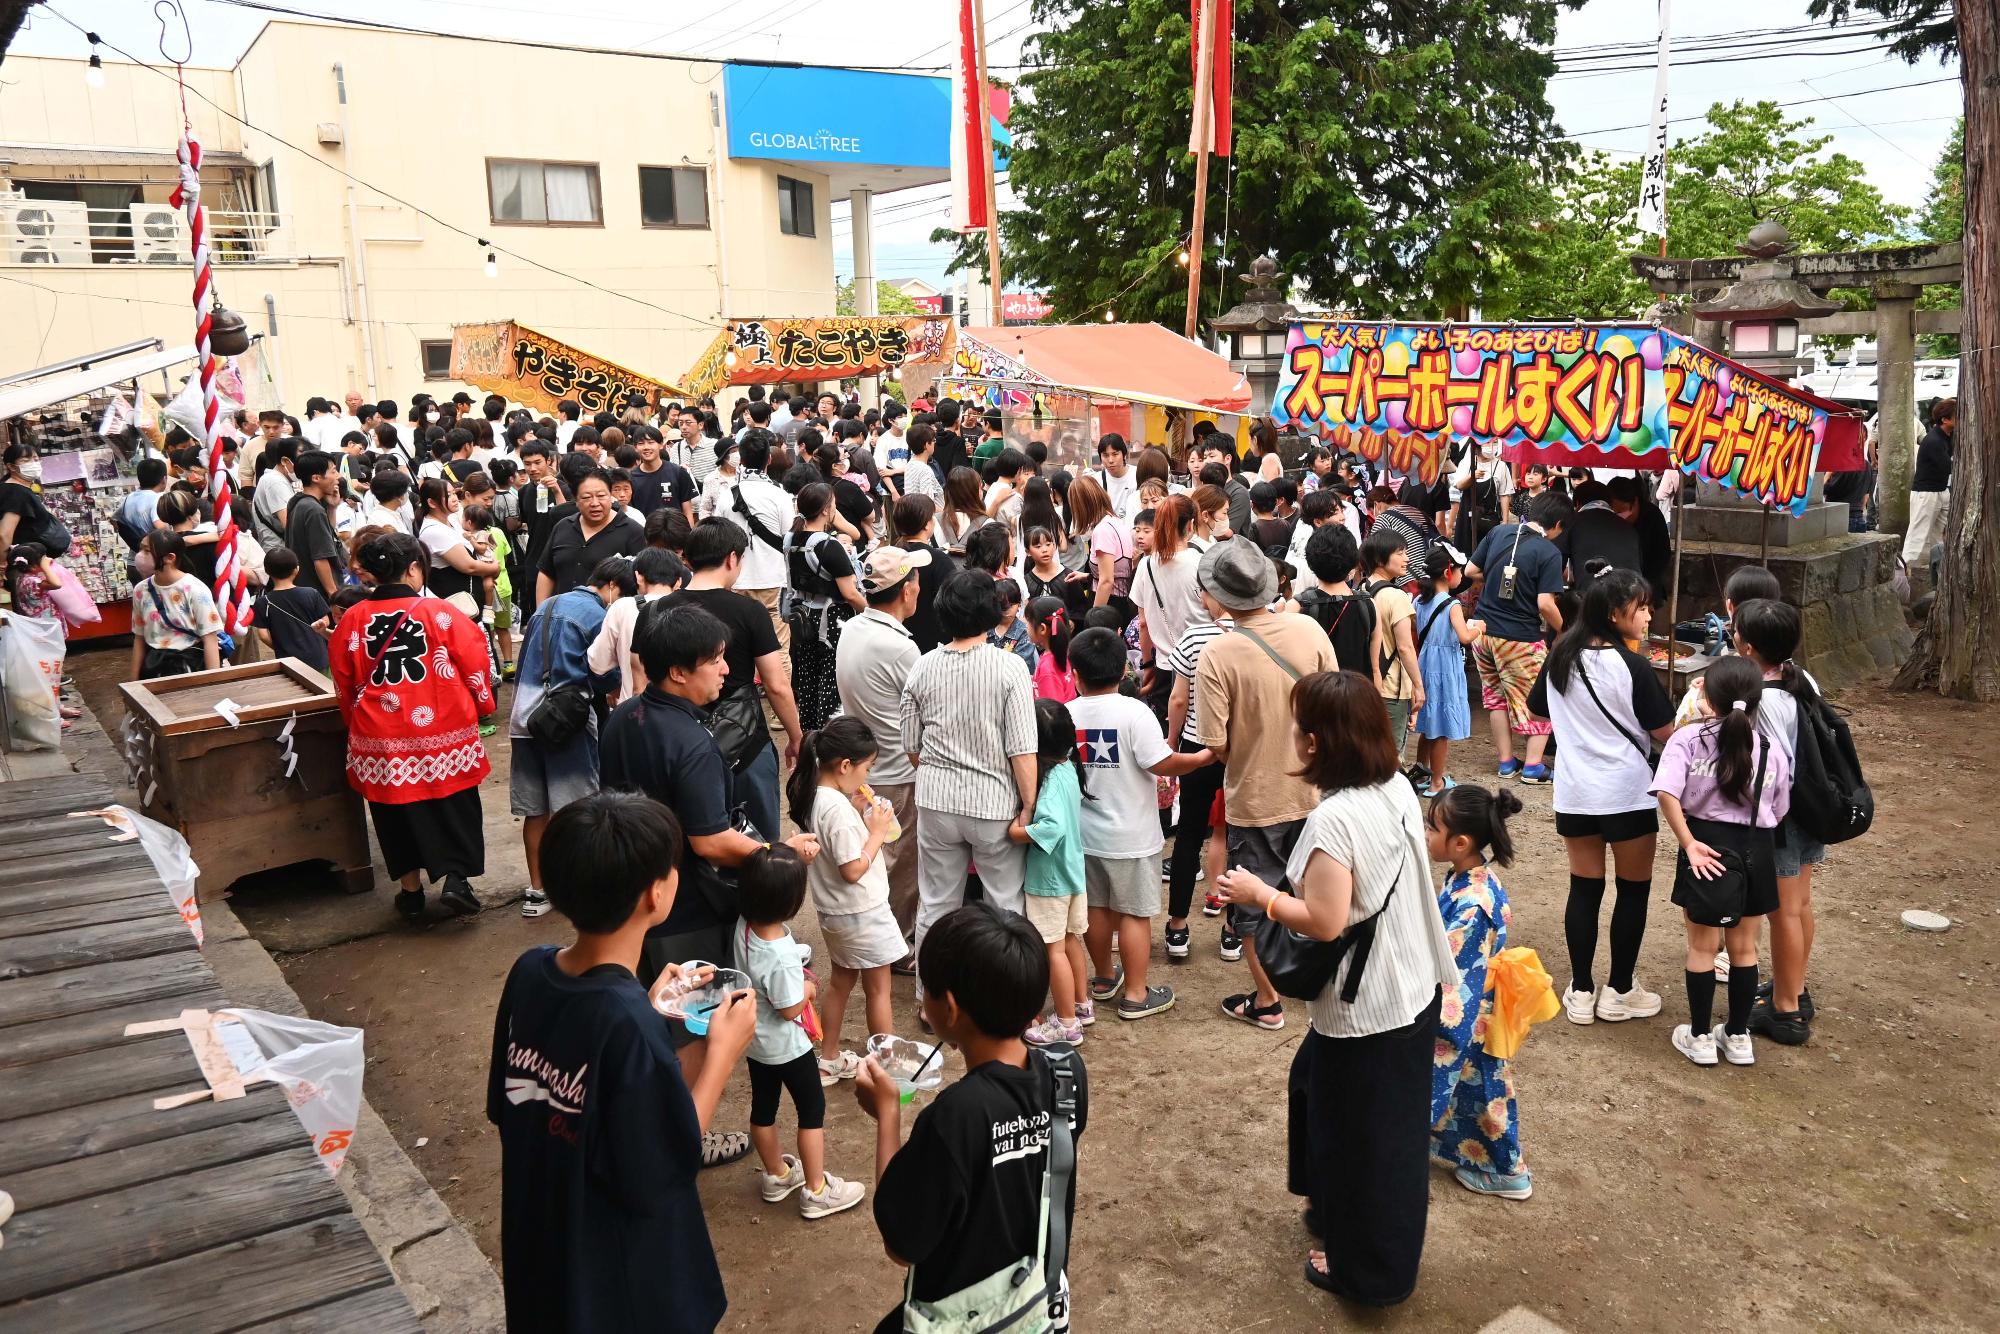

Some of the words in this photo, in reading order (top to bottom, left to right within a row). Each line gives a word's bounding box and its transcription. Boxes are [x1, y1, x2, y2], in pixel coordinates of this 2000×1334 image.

[750, 132, 817, 150] GLOBAL
[819, 136, 861, 153] TREE
[735, 321, 775, 366] 極上
[776, 327, 910, 367] たこやき
[1321, 326, 1388, 349] 大人気!
[1410, 328, 1599, 353] よい子のあそびば!
[512, 339, 648, 421] やきそば
[1284, 344, 1645, 445] スーパーボールすくい
[362, 610, 428, 687] 祭
[994, 1133, 1015, 1154] vai
